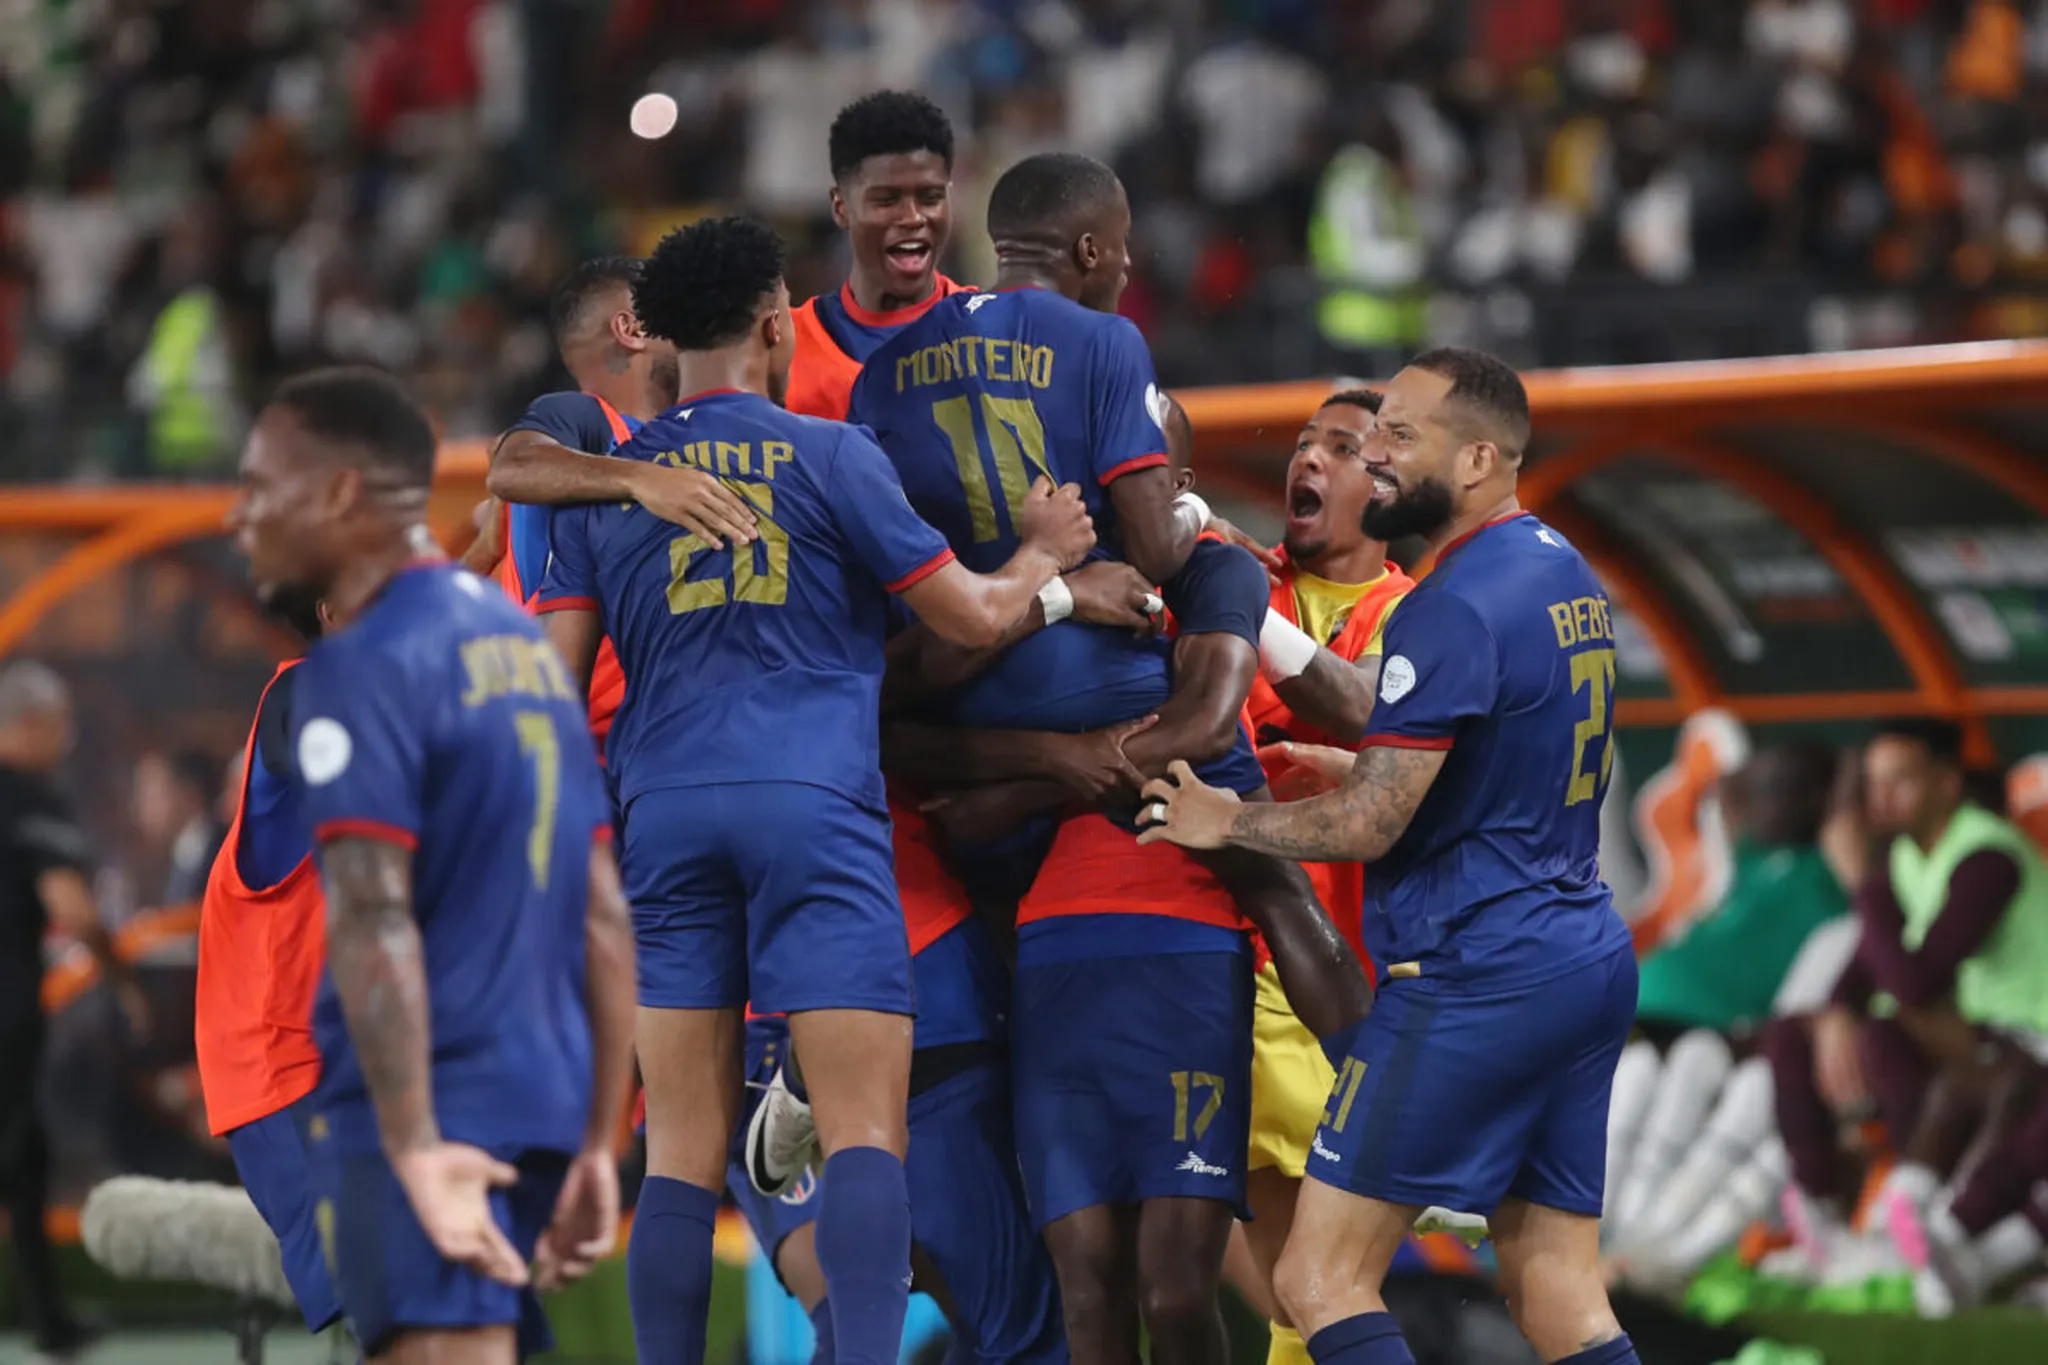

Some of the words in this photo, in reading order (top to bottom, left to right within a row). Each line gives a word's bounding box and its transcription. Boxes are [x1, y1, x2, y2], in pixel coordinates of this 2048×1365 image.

[895, 335, 1055, 393] MONTERO
[932, 392, 1057, 545] 10
[1170, 1071, 1225, 1141] 17
